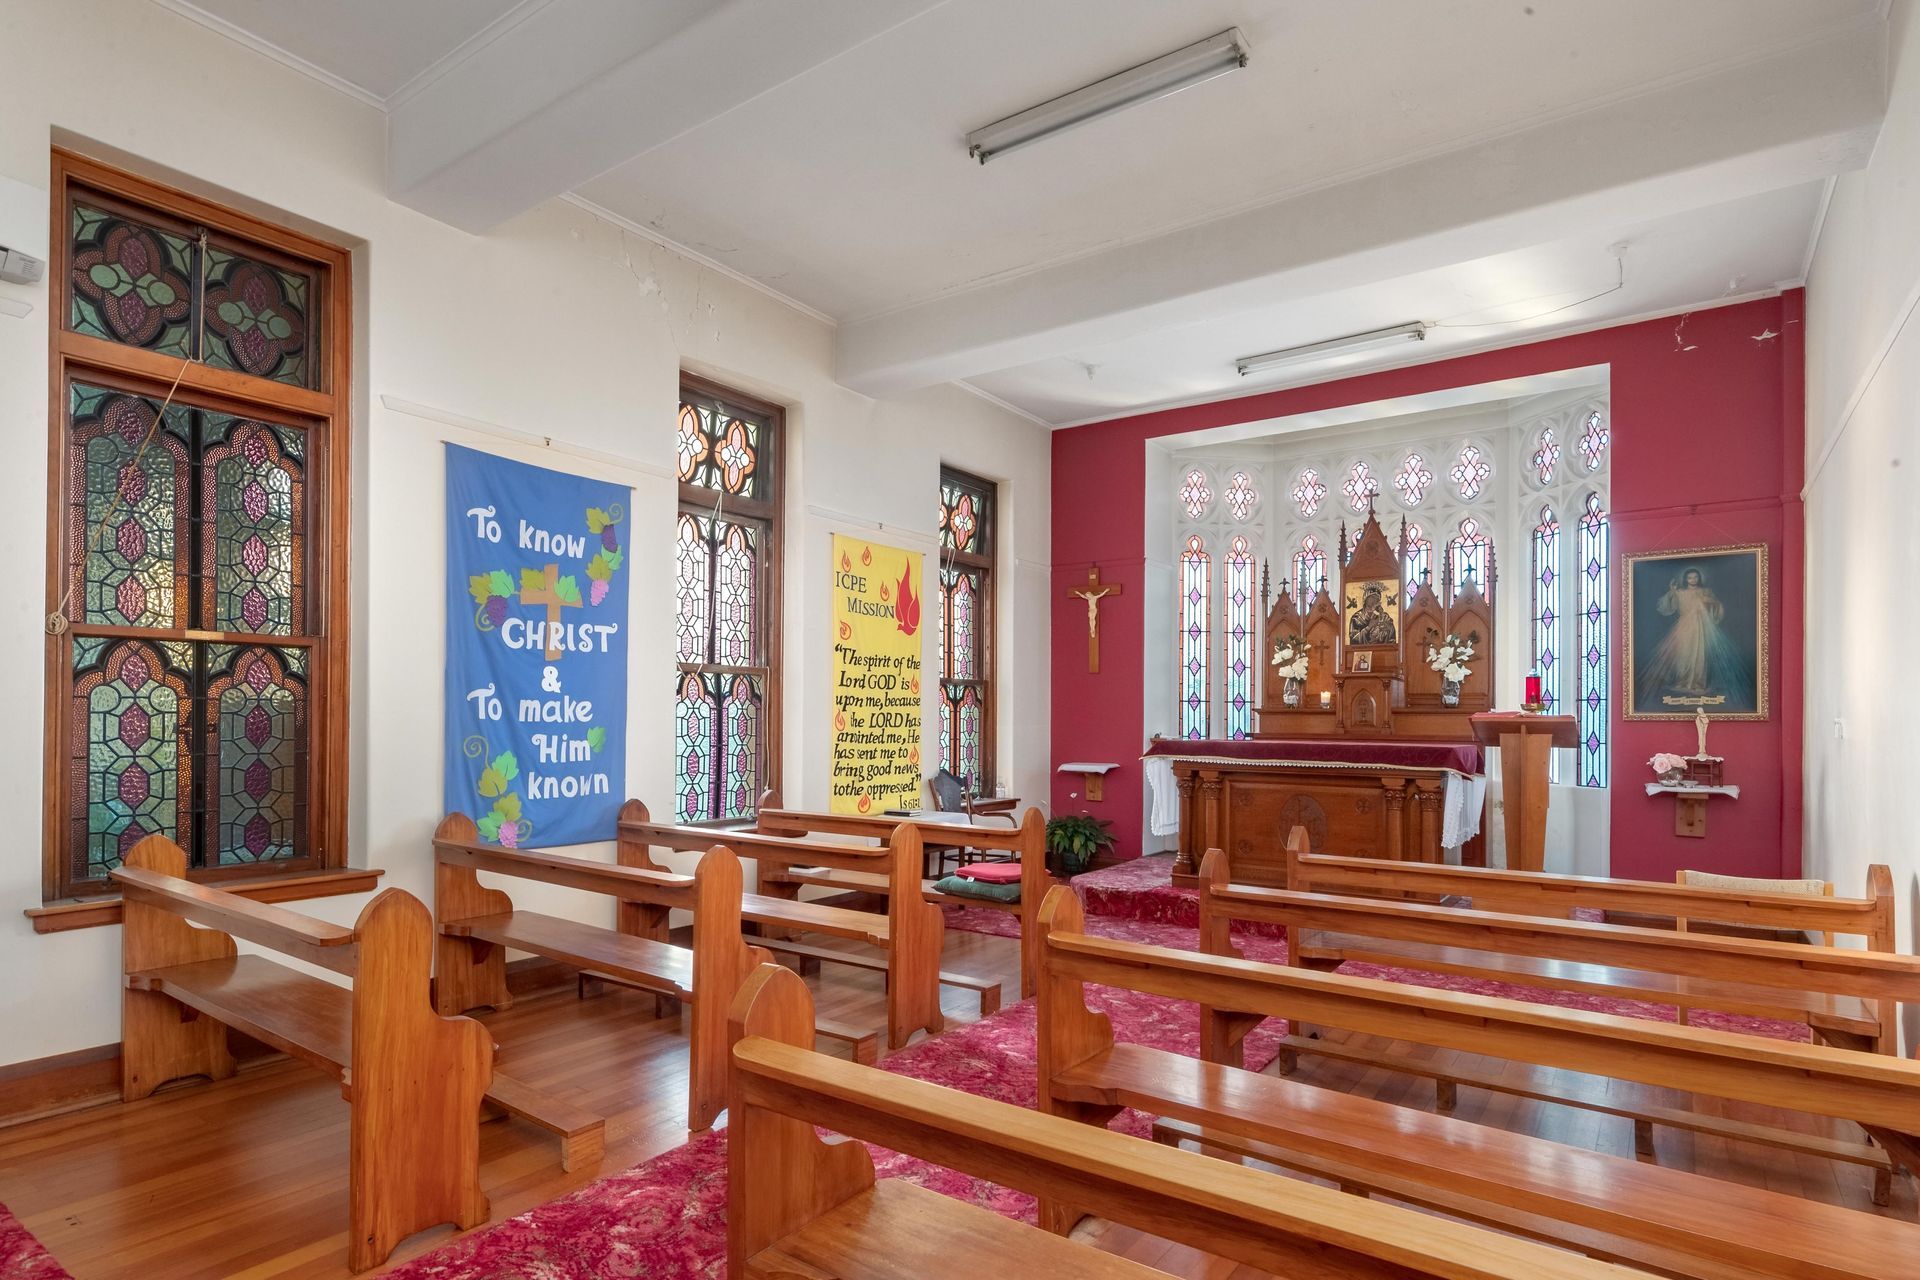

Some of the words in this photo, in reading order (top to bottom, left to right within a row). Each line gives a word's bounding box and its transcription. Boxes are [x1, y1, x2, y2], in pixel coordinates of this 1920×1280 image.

[466, 505, 501, 543] To
[519, 519, 586, 559] know
[835, 571, 867, 593] ICPE
[847, 596, 895, 619] MISSION
[501, 617, 618, 653] CHRIST
[863, 654, 891, 672] spirit
[893, 657, 905, 677] of
[906, 654, 921, 670] the
[541, 665, 561, 693] &
[838, 670, 867, 690] Lord
[868, 674, 897, 690] GOD
[901, 677, 910, 690] is
[466, 682, 502, 721] To
[518, 695, 593, 723] make
[835, 695, 864, 712] upon
[865, 695, 883, 711] me,
[884, 691, 921, 707] because
[850, 711, 865, 728] the
[869, 712, 904, 728] LORD
[904, 713, 921, 728] has
[531, 733, 591, 763] Him
[886, 733, 906, 745] me,
[907, 729, 920, 744] He
[833, 743, 855, 759] has
[856, 747, 878, 760] sent
[880, 748, 896, 759] me
[898, 746, 909, 759] to
[833, 760, 865, 782] bring
[866, 760, 893, 781] good
[894, 763, 919, 775] news
[527, 771, 609, 800] known
